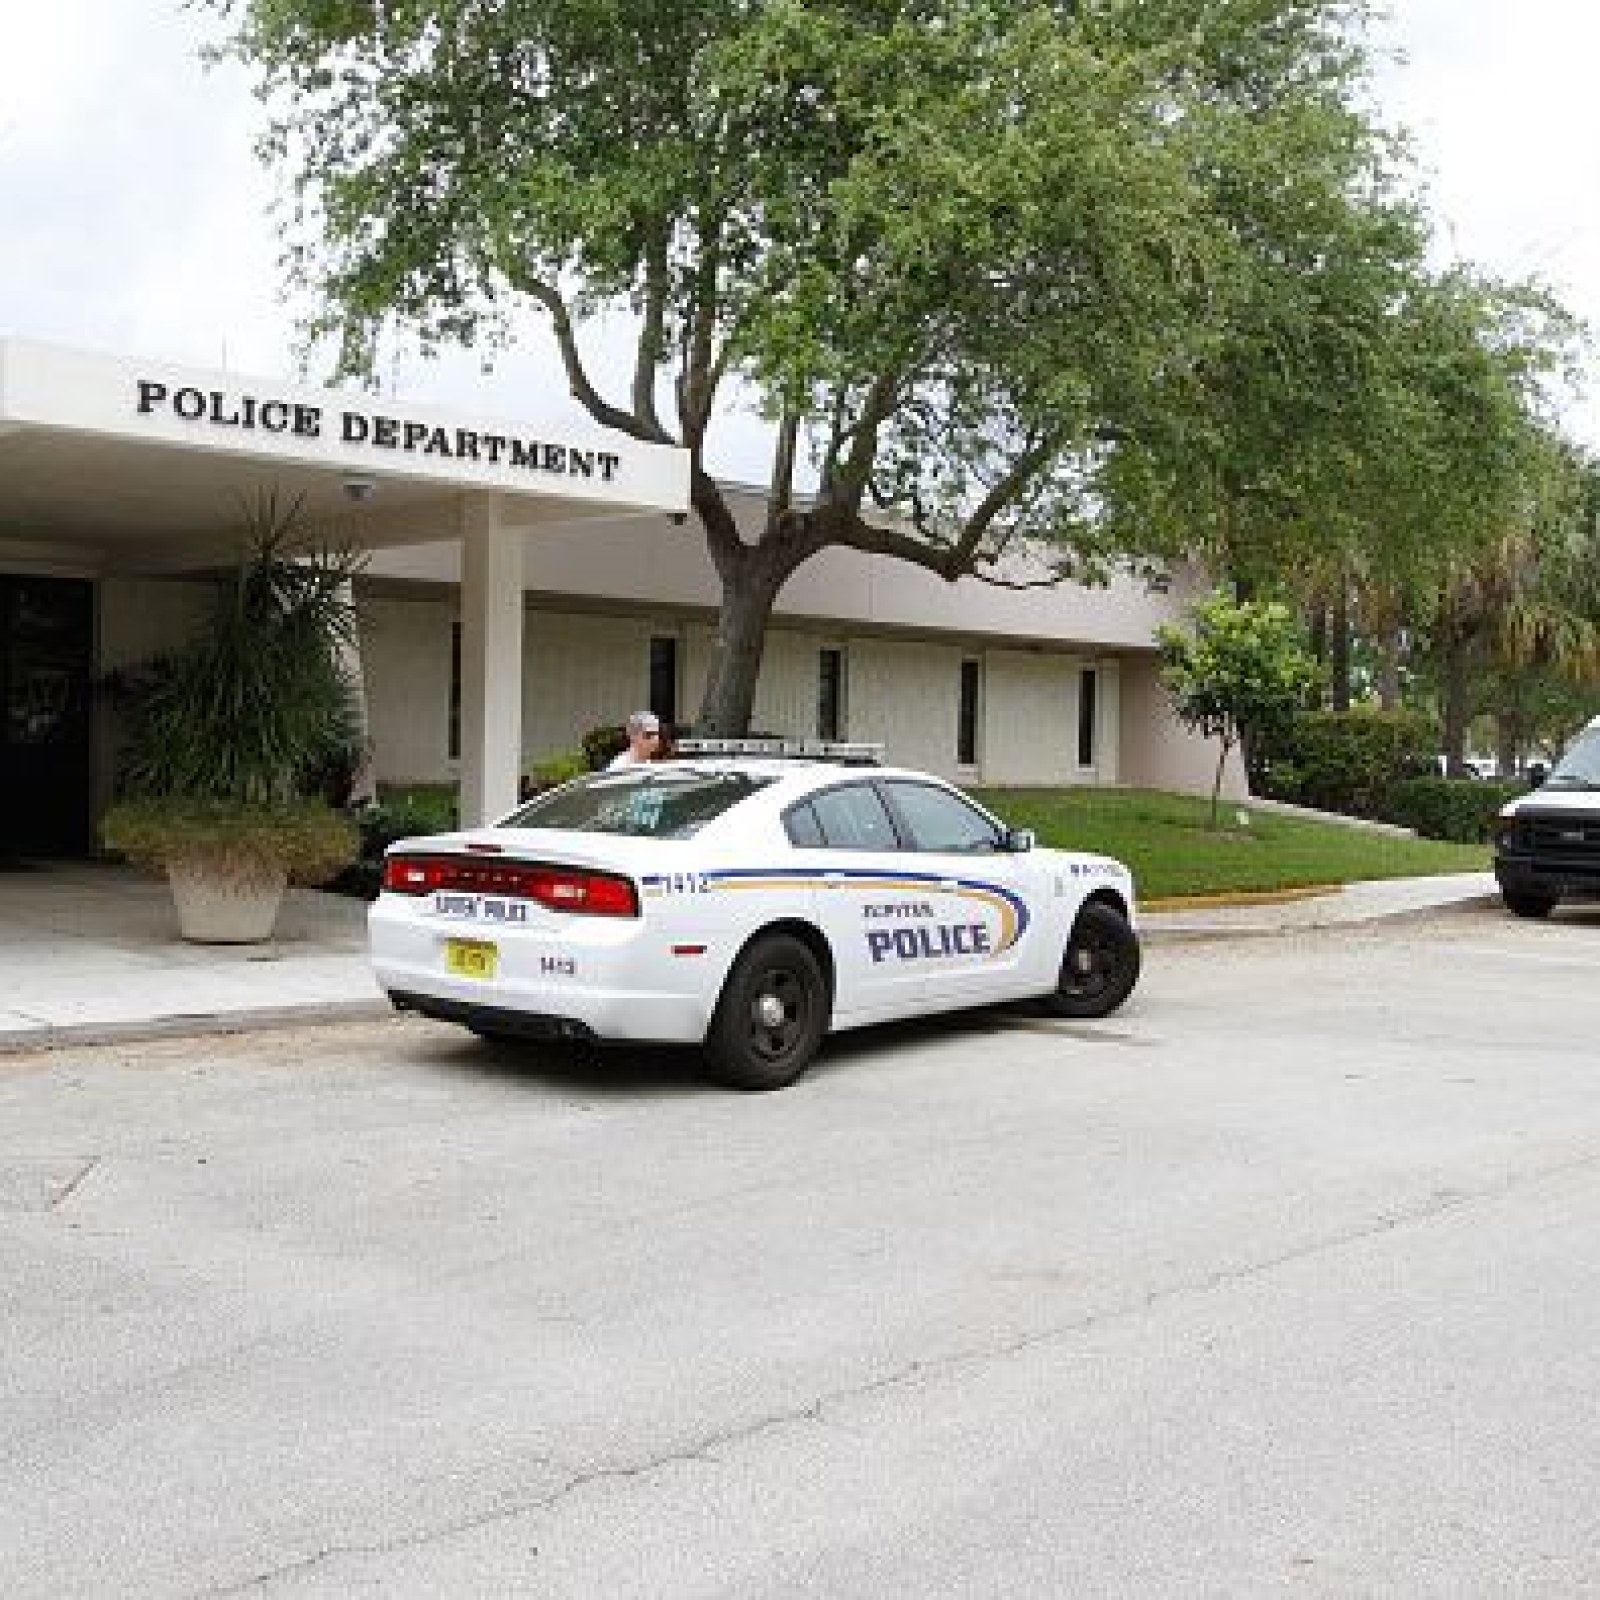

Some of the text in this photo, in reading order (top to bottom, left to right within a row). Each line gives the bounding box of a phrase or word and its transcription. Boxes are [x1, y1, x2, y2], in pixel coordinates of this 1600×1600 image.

[137, 379, 621, 482] POLICE DEPARTMENT
[867, 924, 991, 963] POLICE
